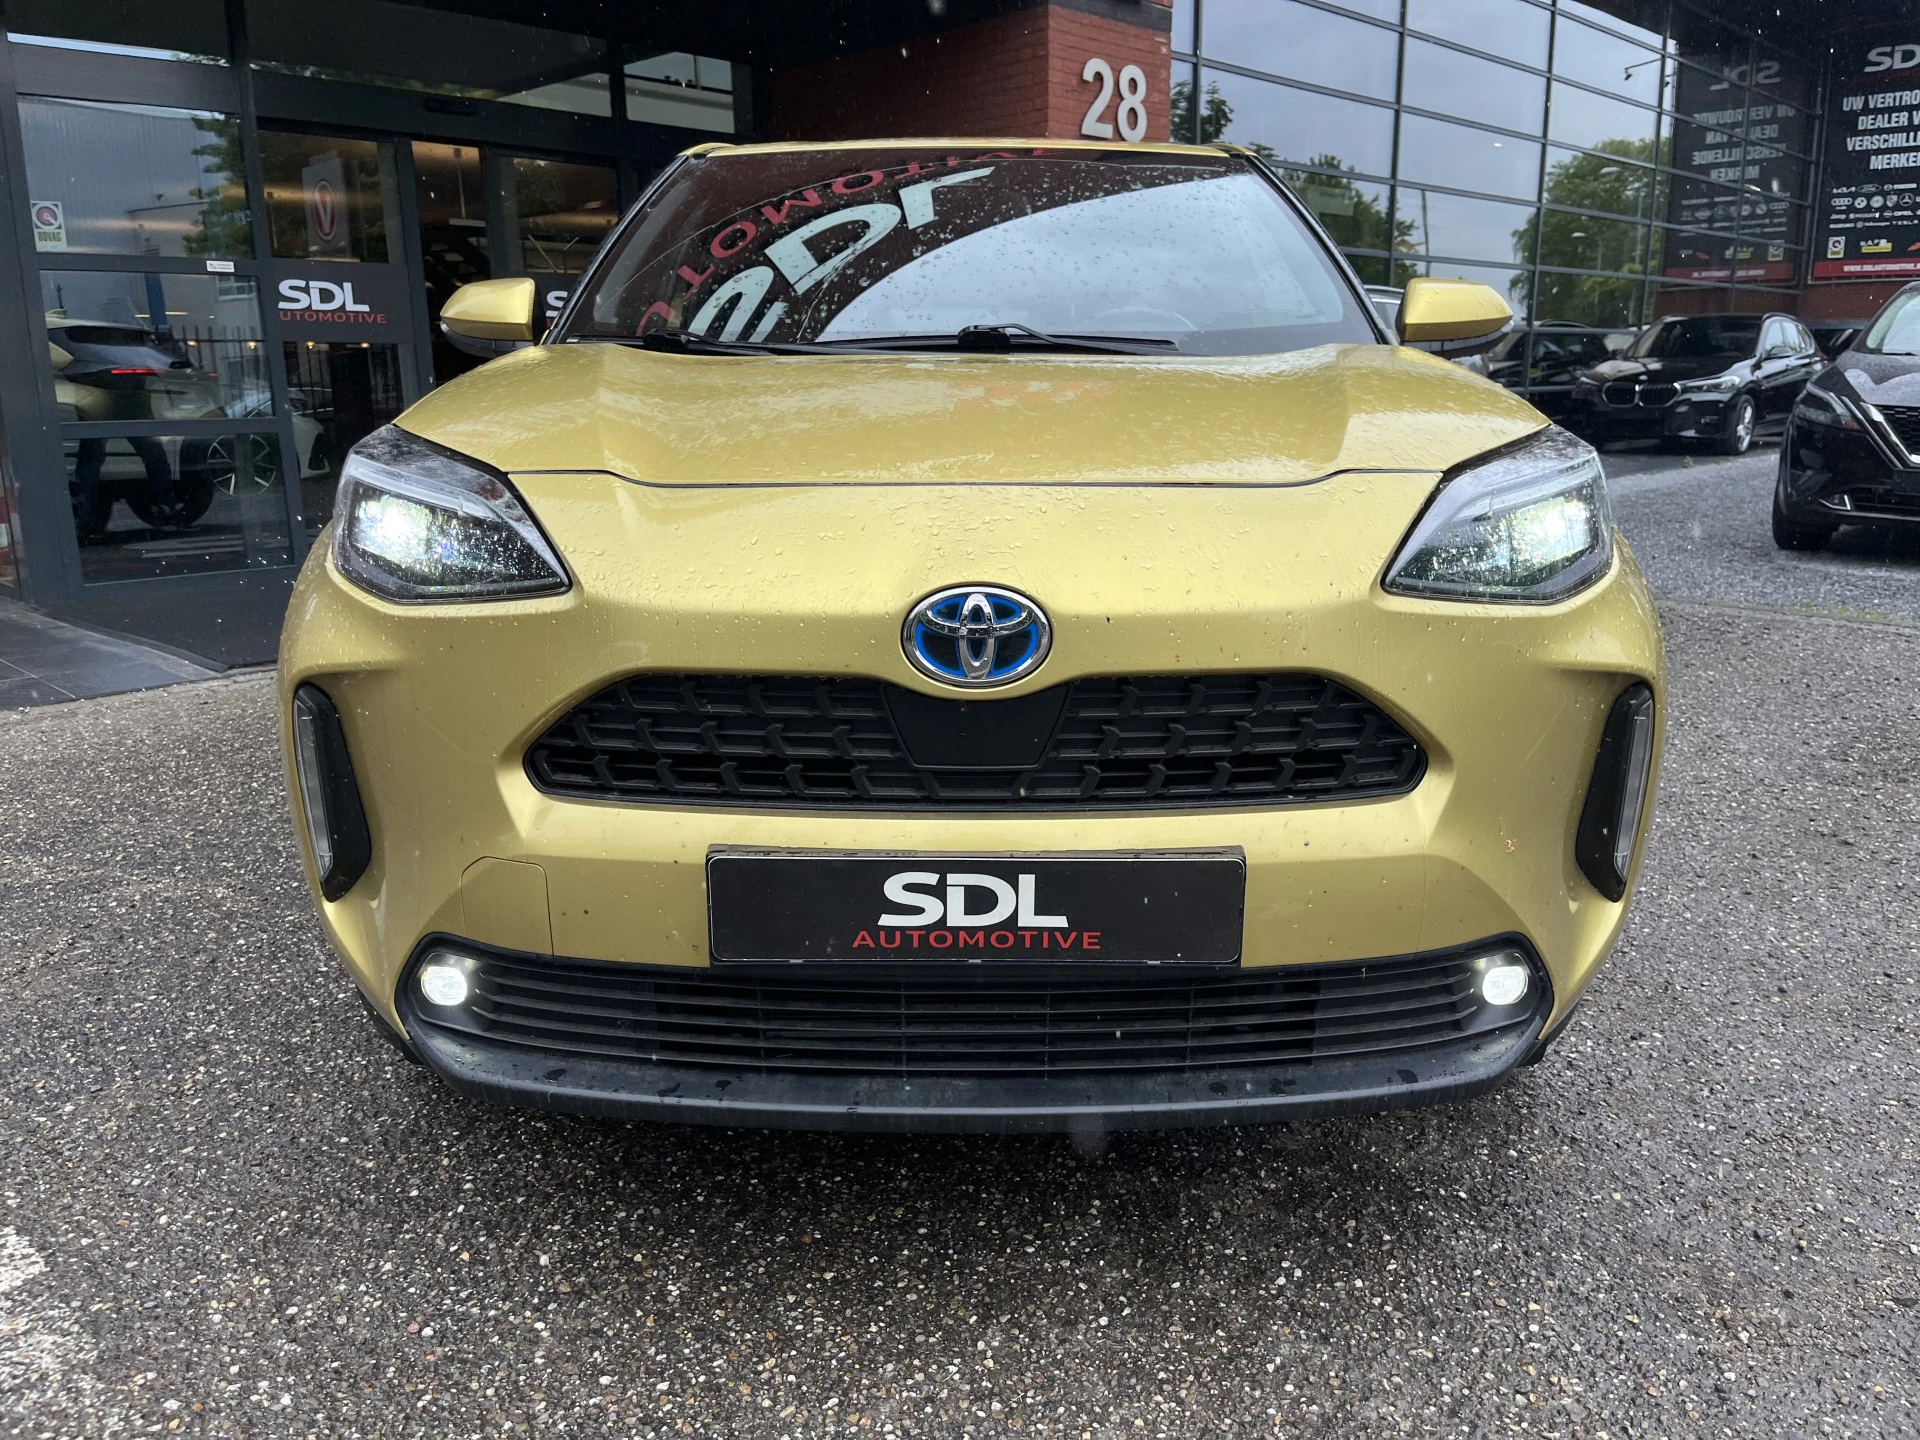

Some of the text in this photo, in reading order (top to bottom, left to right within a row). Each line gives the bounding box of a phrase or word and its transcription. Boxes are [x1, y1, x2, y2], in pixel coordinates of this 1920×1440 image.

[1081, 57, 1147, 142] 28
[1842, 96, 1865, 111] UW
[1857, 111, 1909, 130] DEALER
[278, 279, 370, 312] SDL
[280, 310, 387, 324] UTOMOTIVE
[877, 871, 1069, 928] SDL
[851, 930, 1102, 950] AUTOMOTIVE
